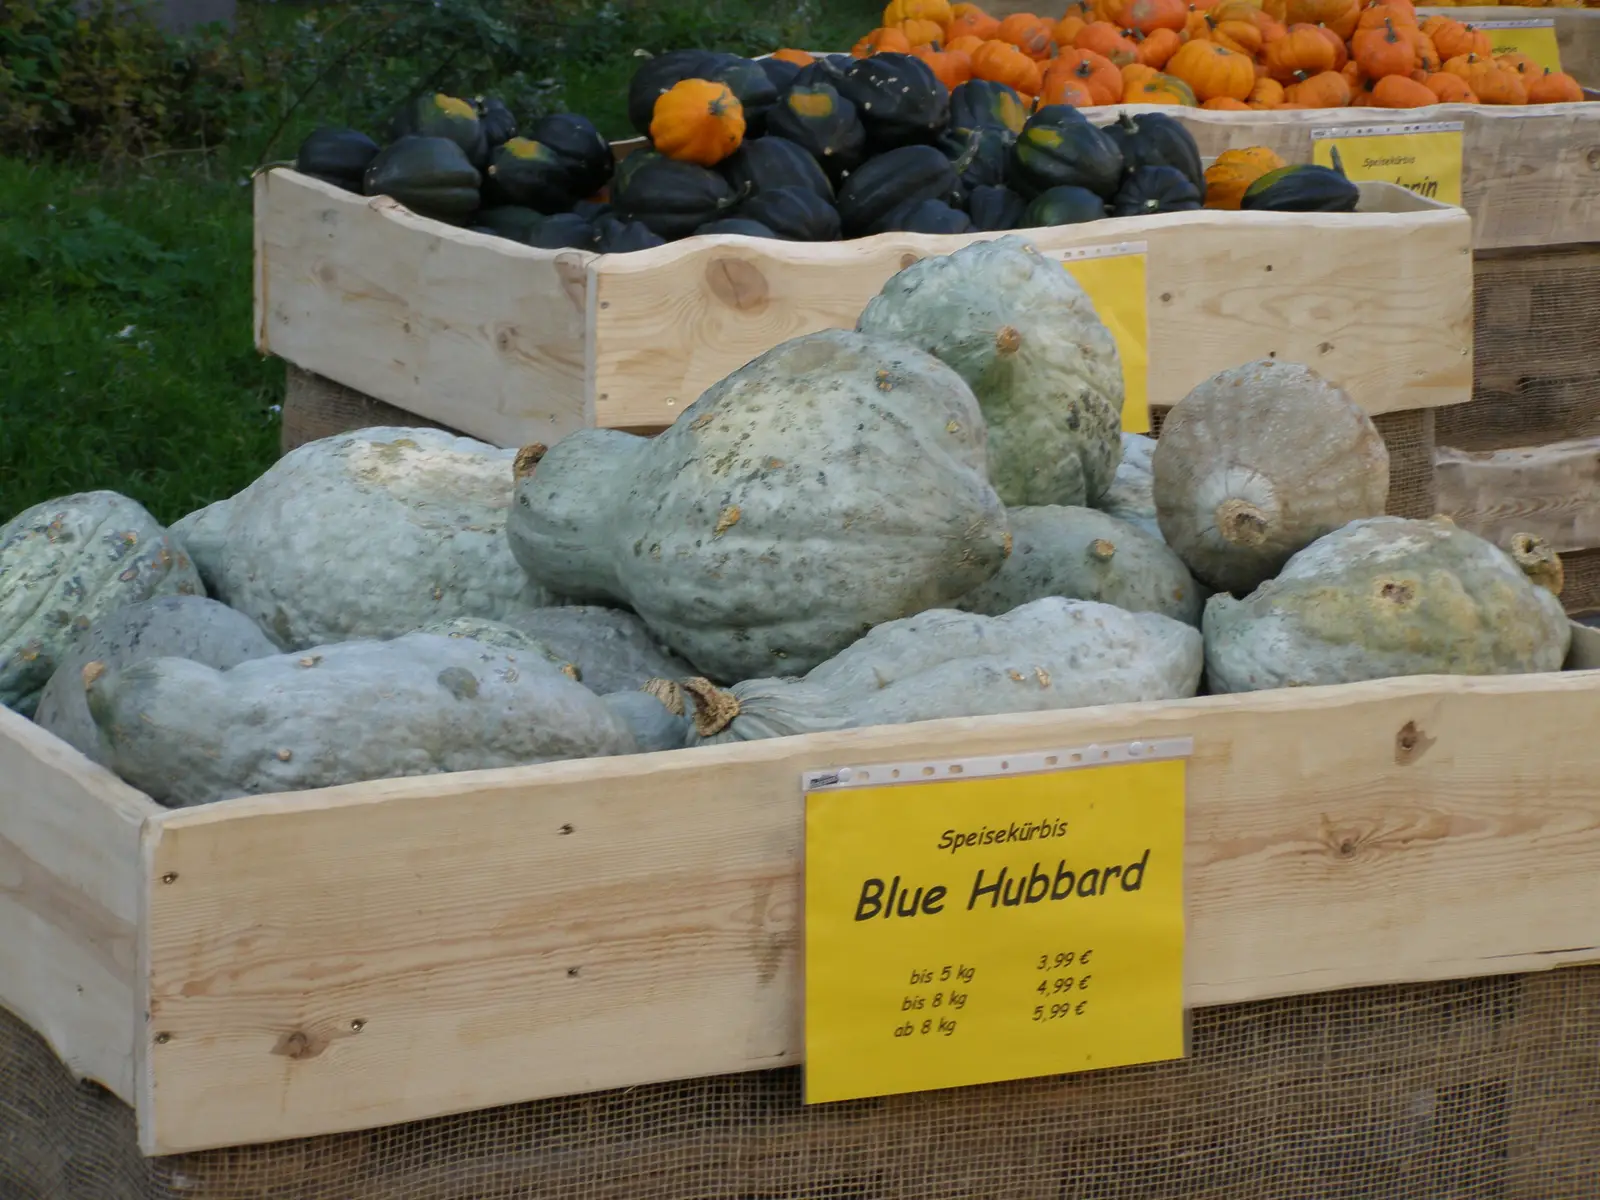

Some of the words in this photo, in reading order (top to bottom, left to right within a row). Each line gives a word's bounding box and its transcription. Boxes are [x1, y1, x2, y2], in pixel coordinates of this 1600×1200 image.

[937, 818, 1069, 854] Speisekürbis
[854, 876, 948, 921] Blue
[966, 849, 1151, 910] Hubbard
[910, 969, 934, 985] bis
[940, 965, 953, 982] 5
[956, 964, 976, 984] kg
[1036, 951, 1075, 972] 3,99
[1079, 949, 1093, 965] €
[901, 996, 926, 1012] bis
[932, 992, 944, 1008] 8
[948, 990, 969, 1010] kg
[1036, 976, 1074, 998] 4,99
[1079, 974, 1092, 990] €
[894, 1021, 914, 1038] ab
[921, 1018, 933, 1035] 8
[937, 1017, 957, 1037] kg
[1031, 1002, 1070, 1024] 5,99
[1074, 1000, 1088, 1016] €
